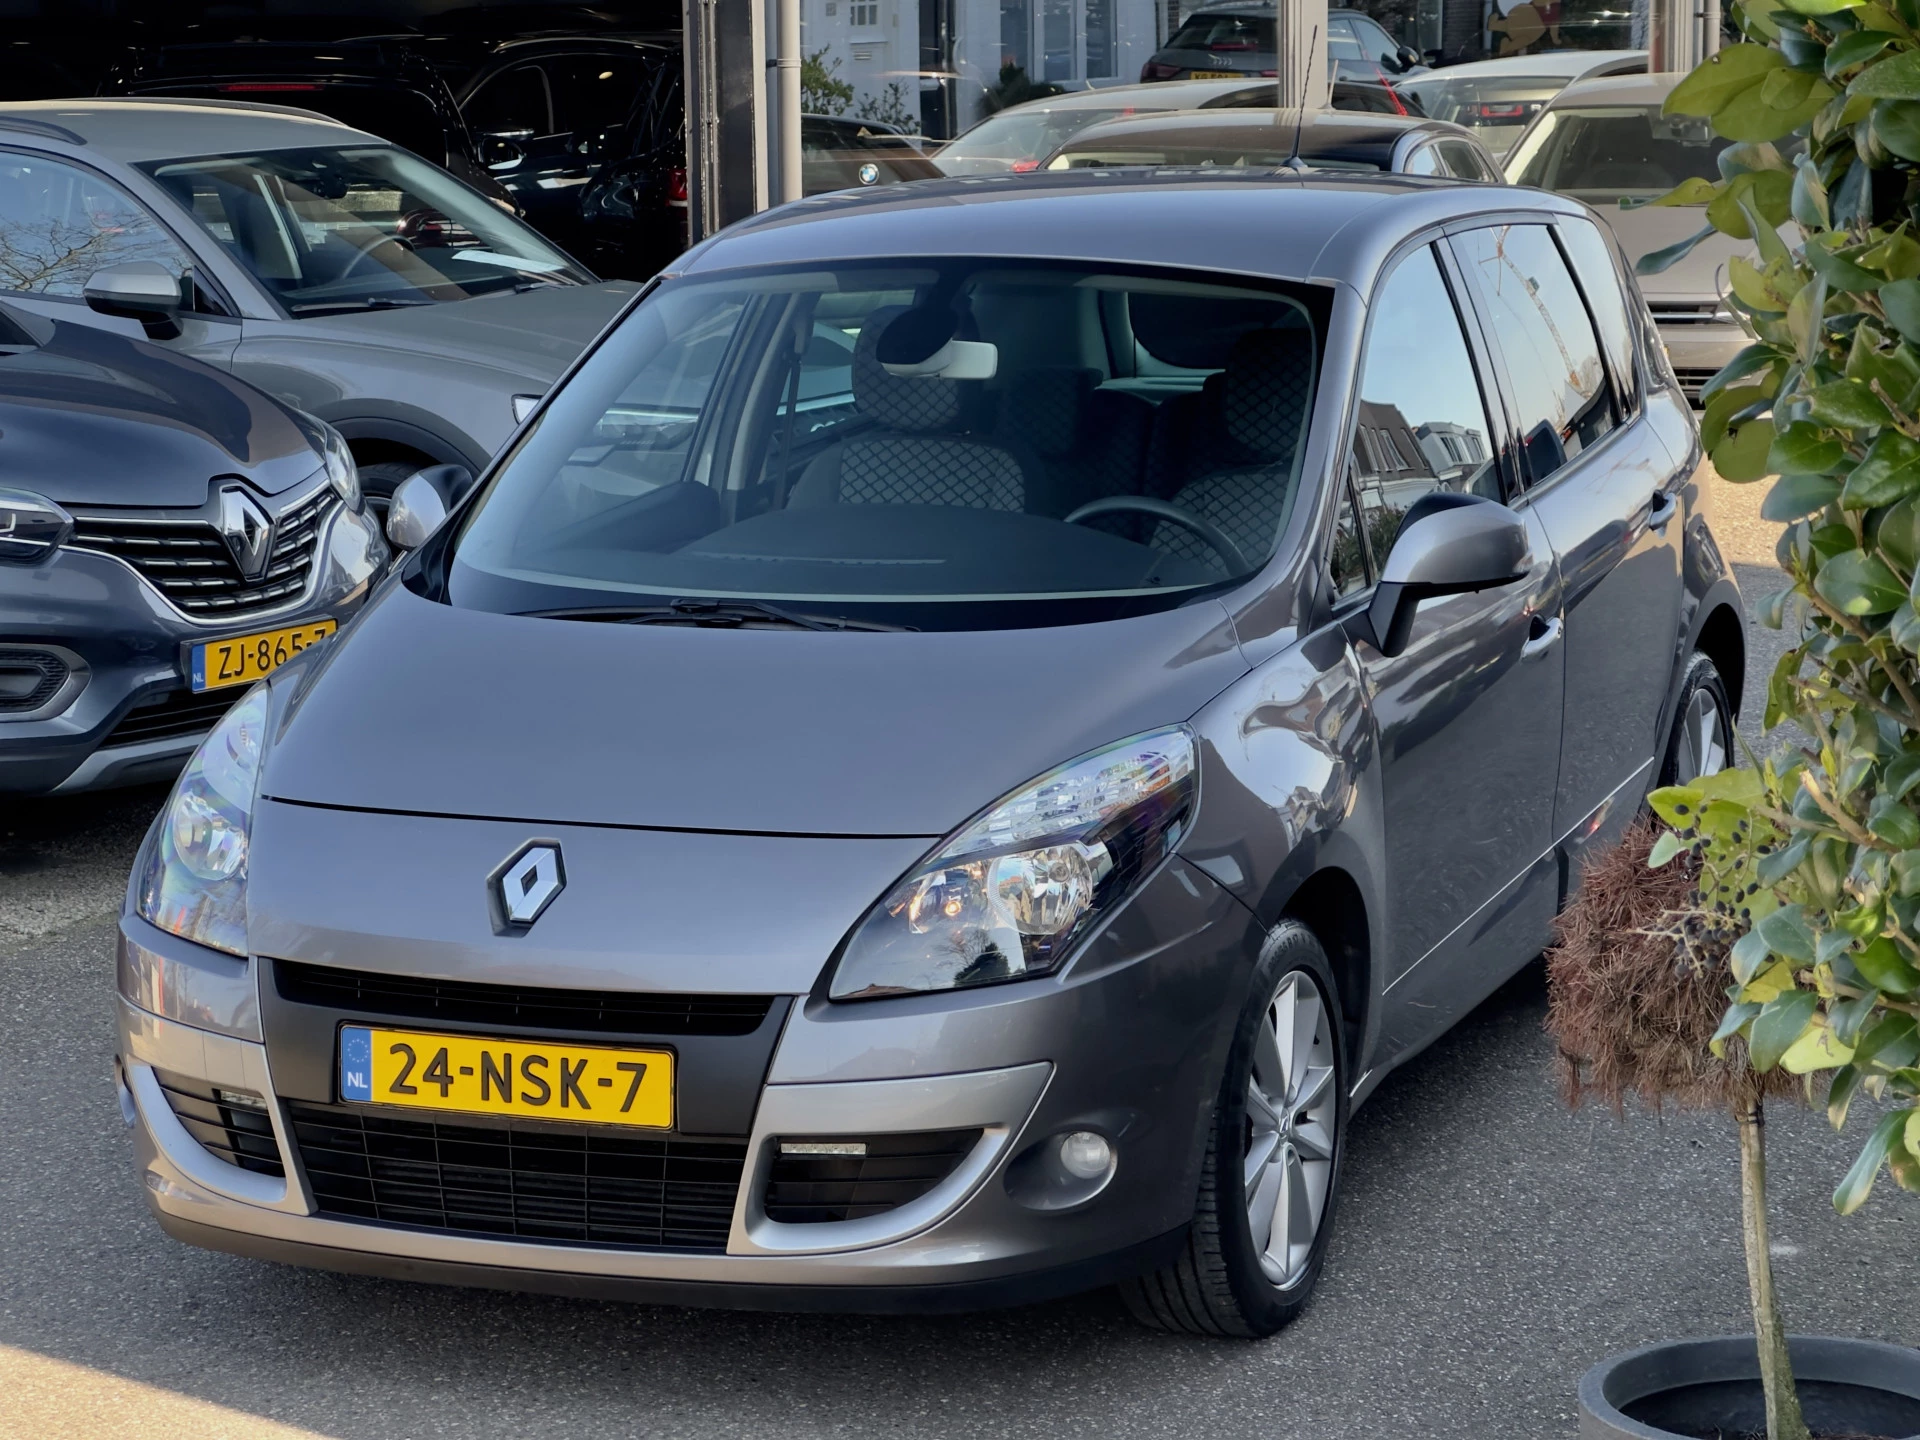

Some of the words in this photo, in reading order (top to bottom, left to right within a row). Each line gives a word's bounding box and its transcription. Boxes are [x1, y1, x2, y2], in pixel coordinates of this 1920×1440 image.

[193, 673, 204, 683] NL
[347, 1071, 368, 1089] NL
[389, 1043, 648, 1113] 24-NSK-7
